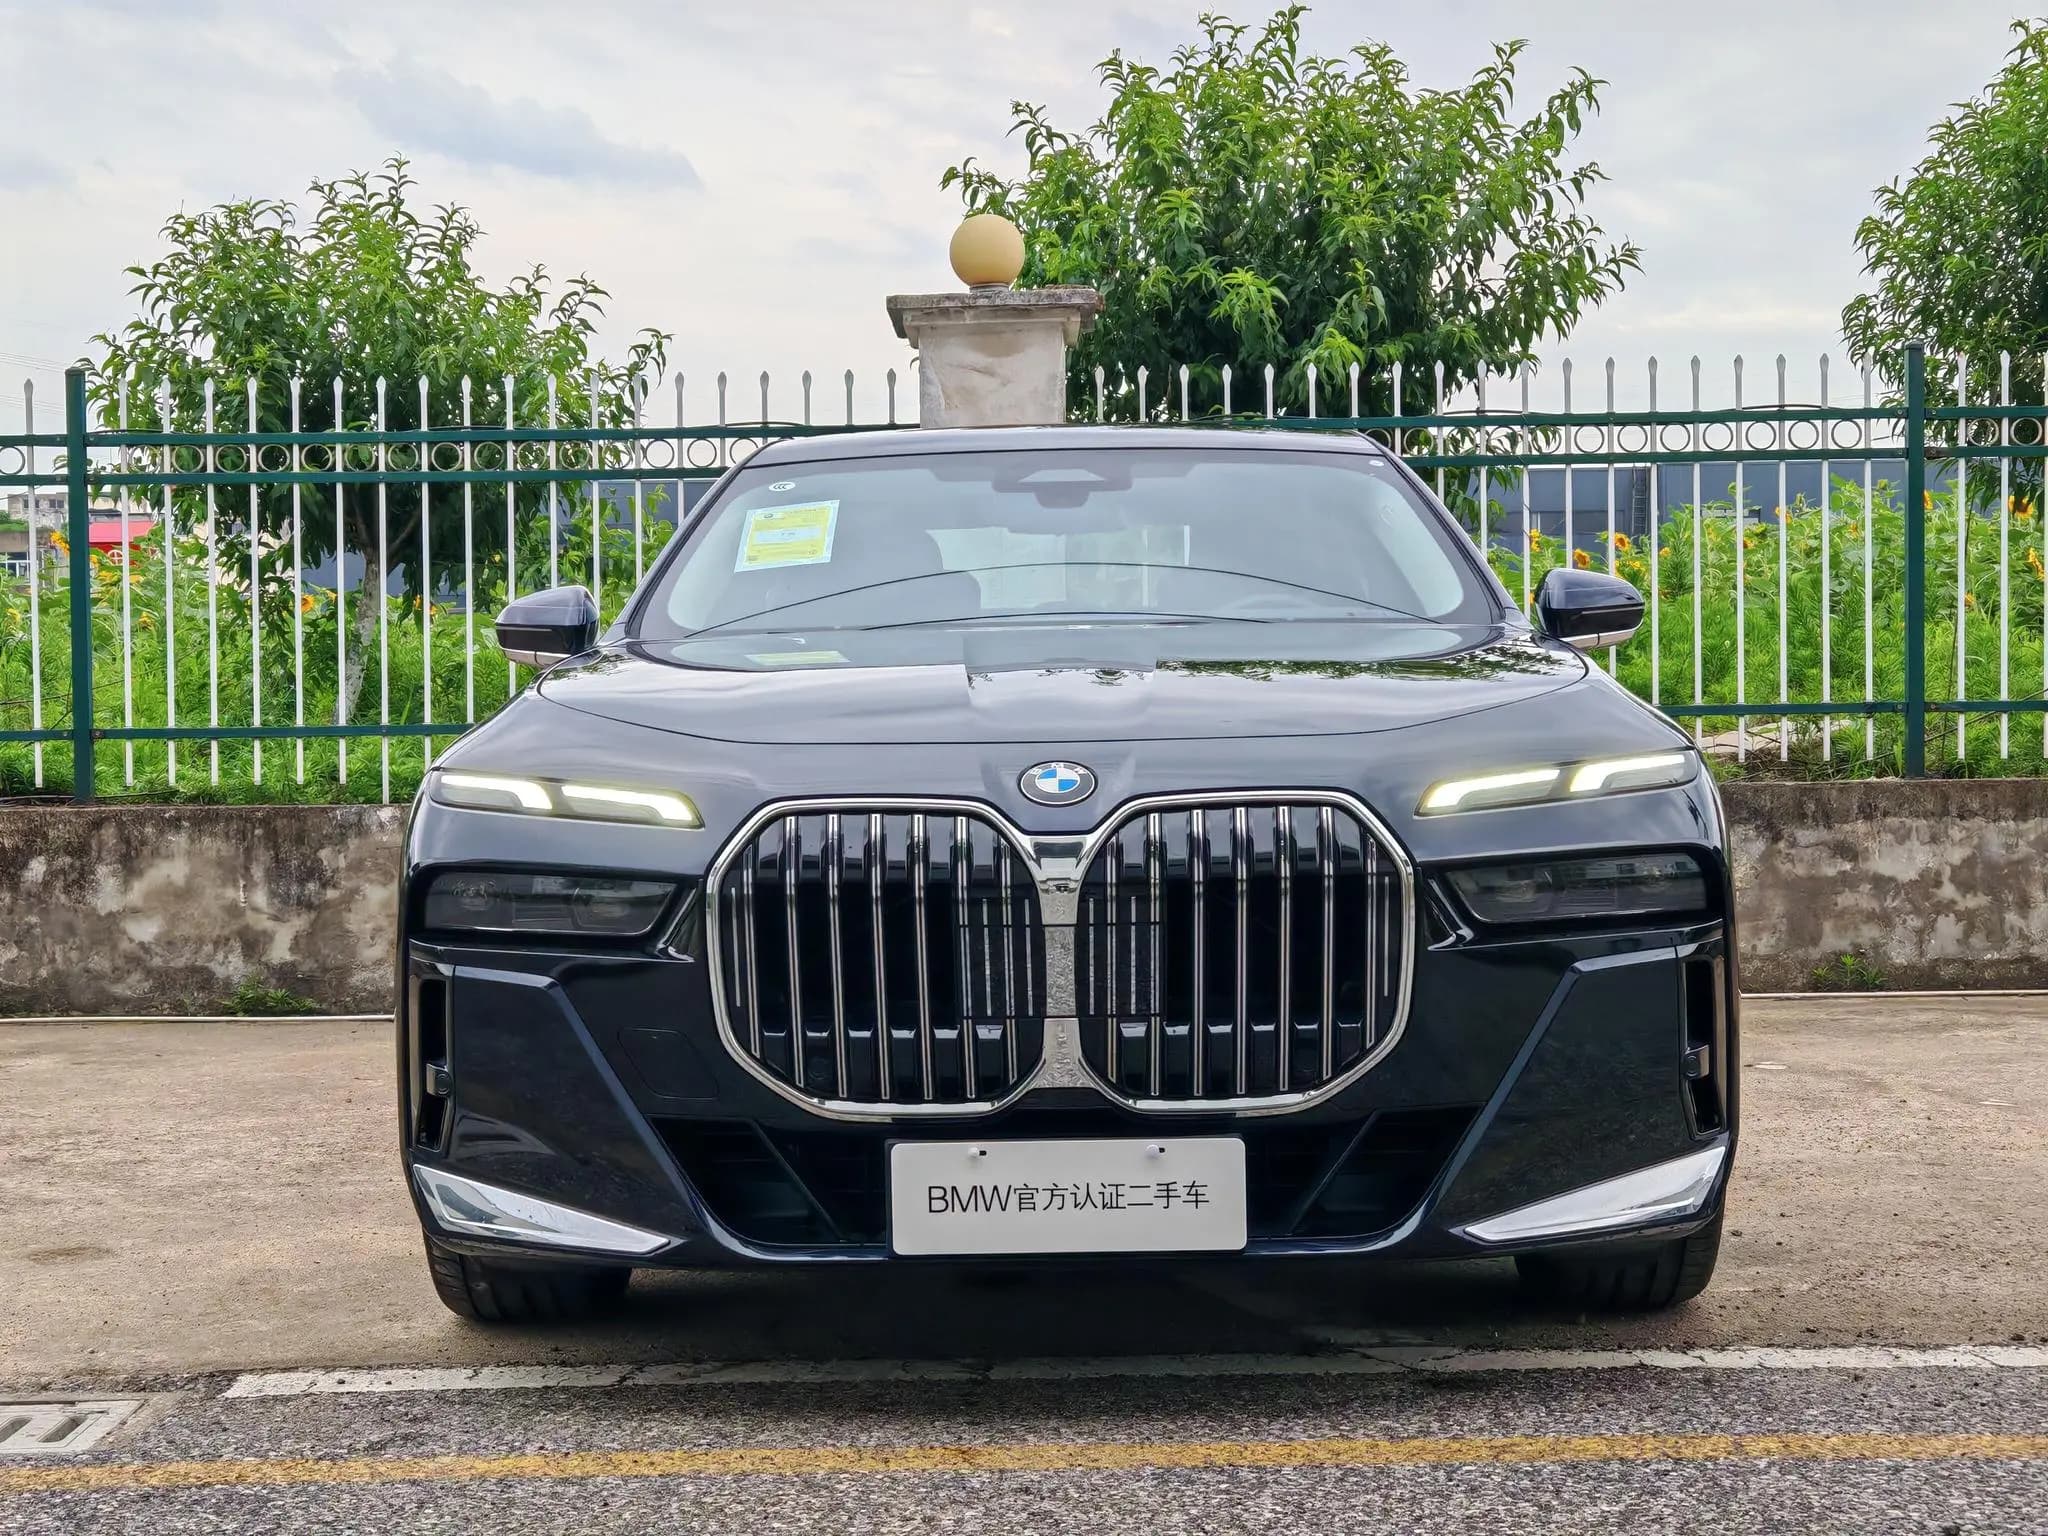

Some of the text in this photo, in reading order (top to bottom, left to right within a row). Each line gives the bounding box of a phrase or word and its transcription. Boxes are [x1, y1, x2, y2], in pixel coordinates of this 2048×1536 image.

[1029, 762, 1087, 775] BMW
[928, 1181, 1210, 1213] BMW官方认证二手车
